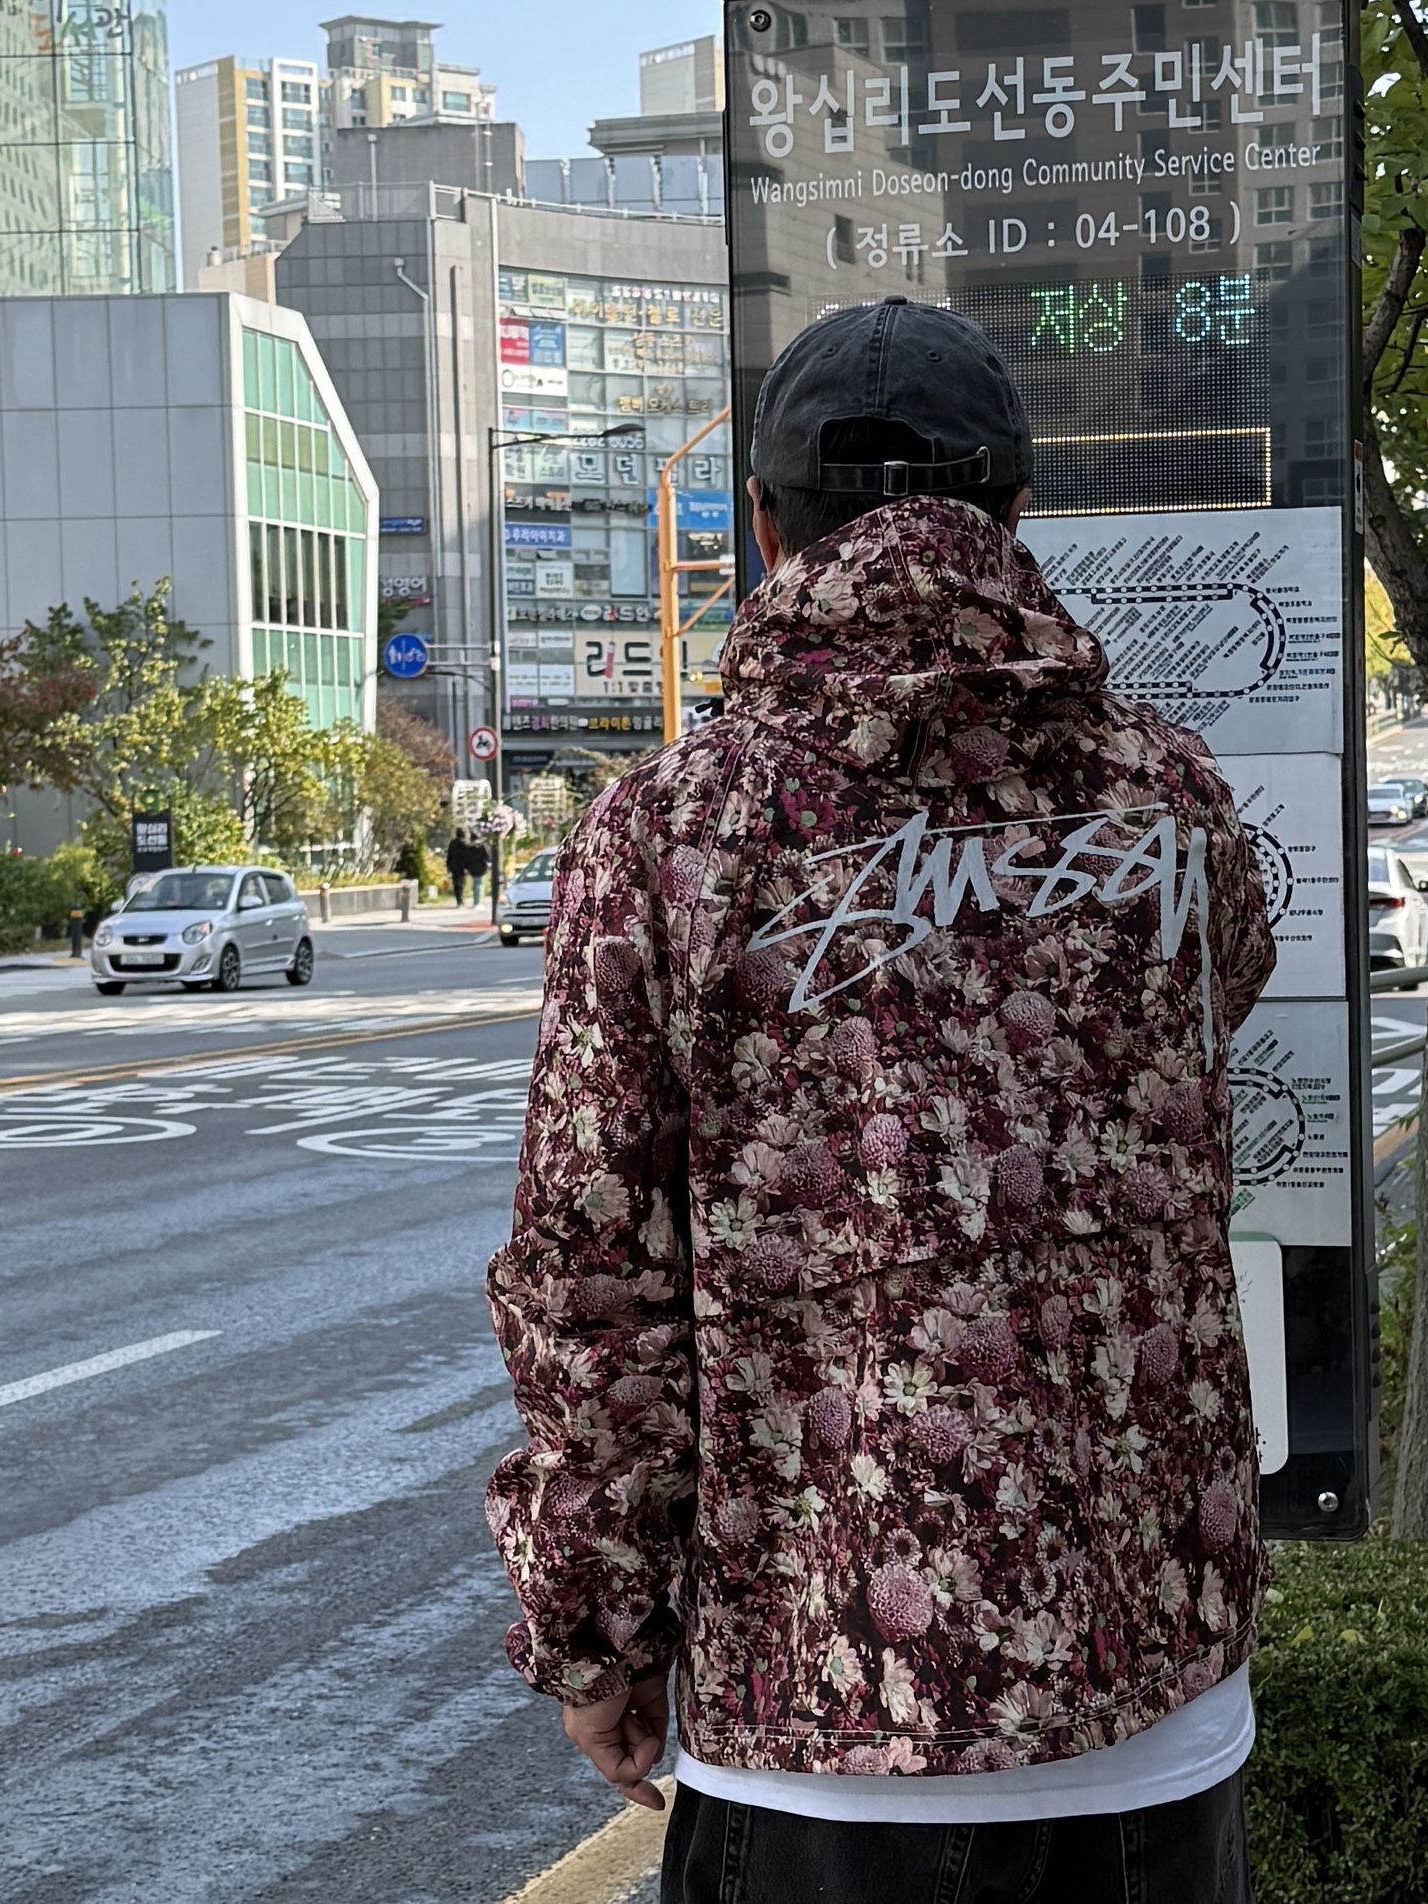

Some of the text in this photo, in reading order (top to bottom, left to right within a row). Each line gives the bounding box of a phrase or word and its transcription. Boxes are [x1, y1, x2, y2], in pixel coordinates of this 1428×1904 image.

[749, 32, 1321, 159] 왕십리도선동주민센터
[750, 142, 1321, 207] Wangsimni Doseon-dong Community Service Center
[855, 222, 969, 269] 정류소
[988, 218, 1028, 254] ID
[1075, 205, 1211, 248] 04-108
[1030, 273, 1256, 354] 저상 8분
